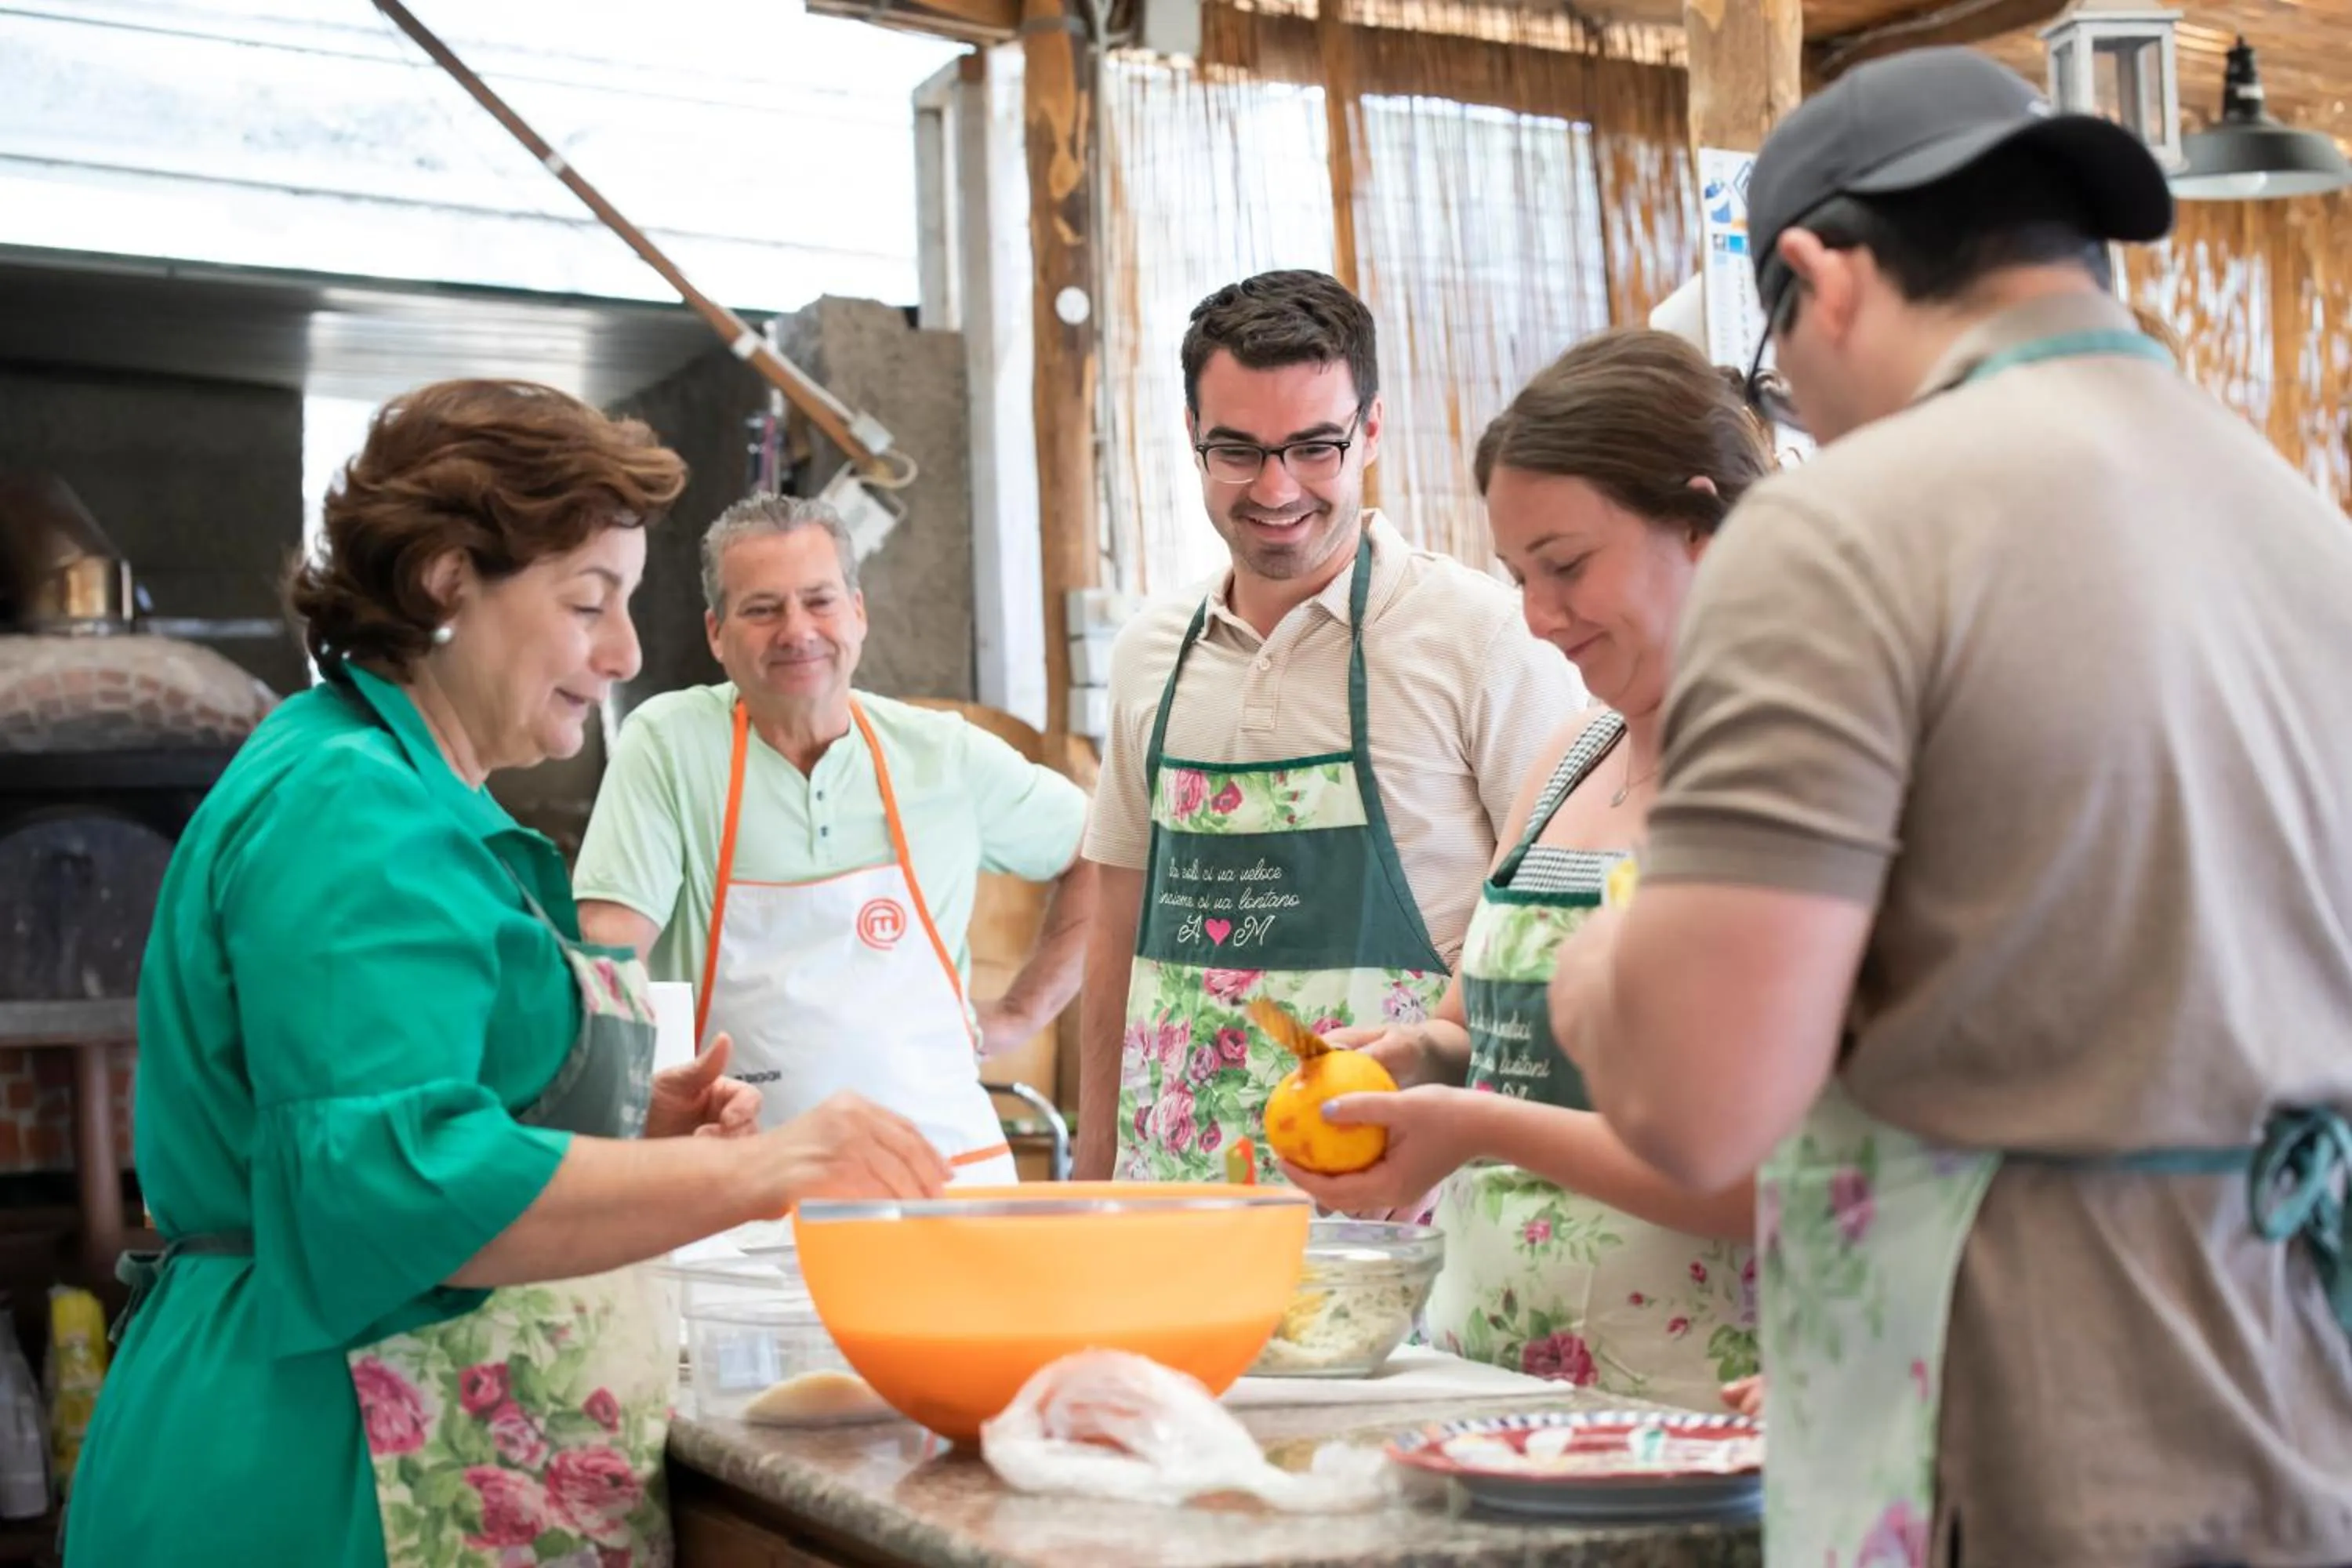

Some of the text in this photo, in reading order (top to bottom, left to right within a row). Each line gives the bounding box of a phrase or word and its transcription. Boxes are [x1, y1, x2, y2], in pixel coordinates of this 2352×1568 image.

[1240, 858, 1283, 881] veloce
[1239, 887, 1300, 909] lontano
[1233, 915, 1276, 947] M
